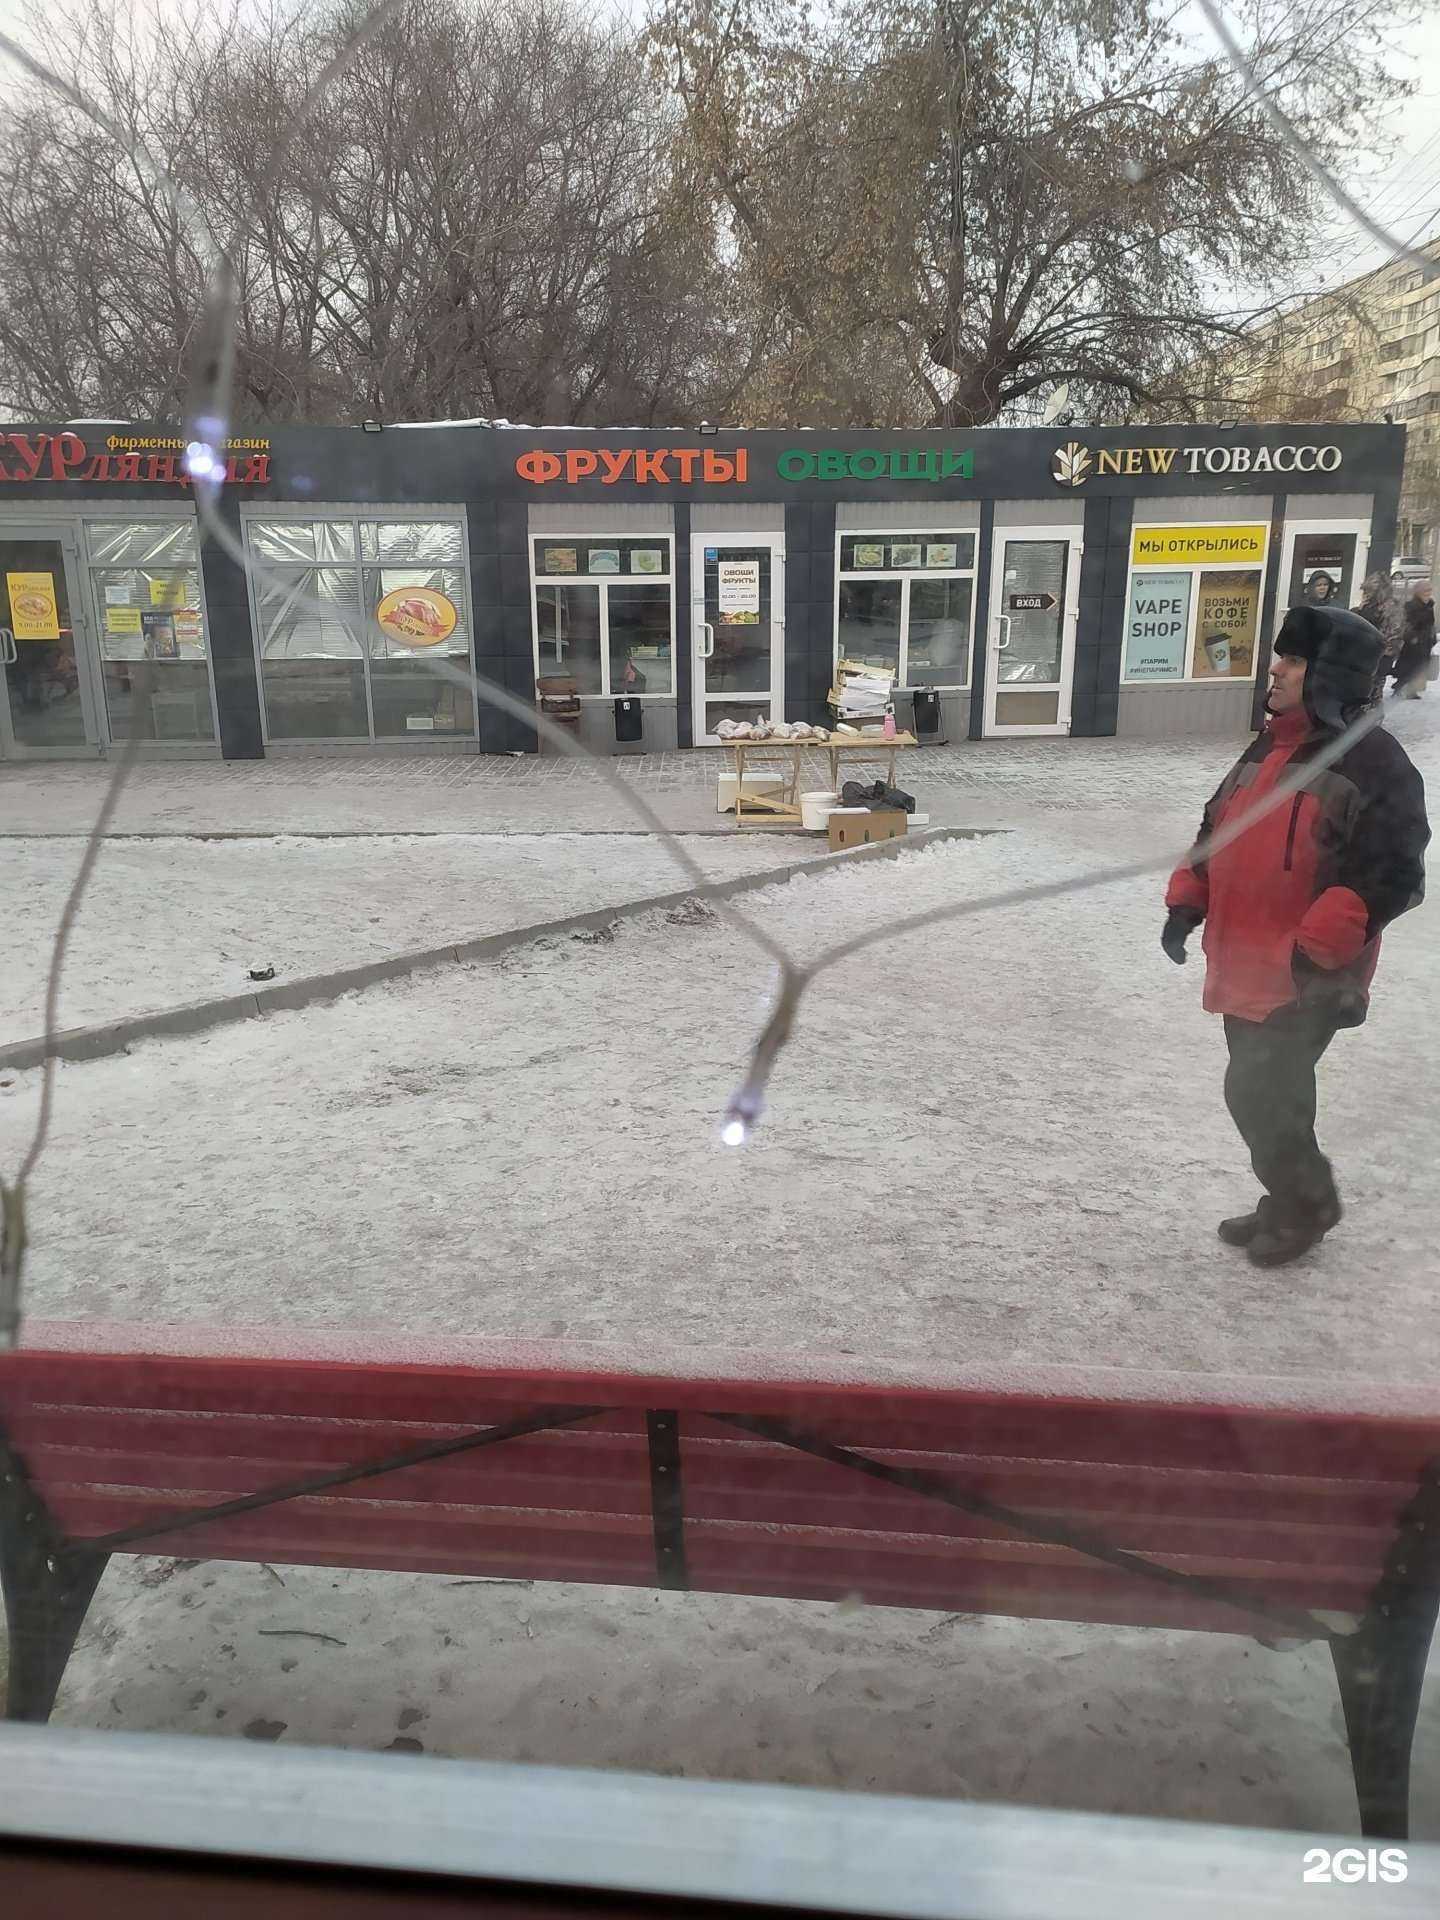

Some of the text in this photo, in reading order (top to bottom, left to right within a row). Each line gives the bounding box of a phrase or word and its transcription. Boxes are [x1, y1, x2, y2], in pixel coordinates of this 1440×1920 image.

[106, 434, 197, 451] фирменны
[515, 448, 975, 484] ФРУКТЫ ОВОЩИ
[1096, 446, 1343, 475] NEW TOBACCO
[1139, 538, 1258, 553] МЫ ОТКРЫЛИСЬ
[1016, 599, 1042, 608] ВХОД
[1135, 599, 1183, 615] VAPE
[1204, 597, 1250, 608] ВОЗЬМИ
[1203, 607, 1249, 620] КОФЕ
[1131, 621, 1182, 638] SHOP
